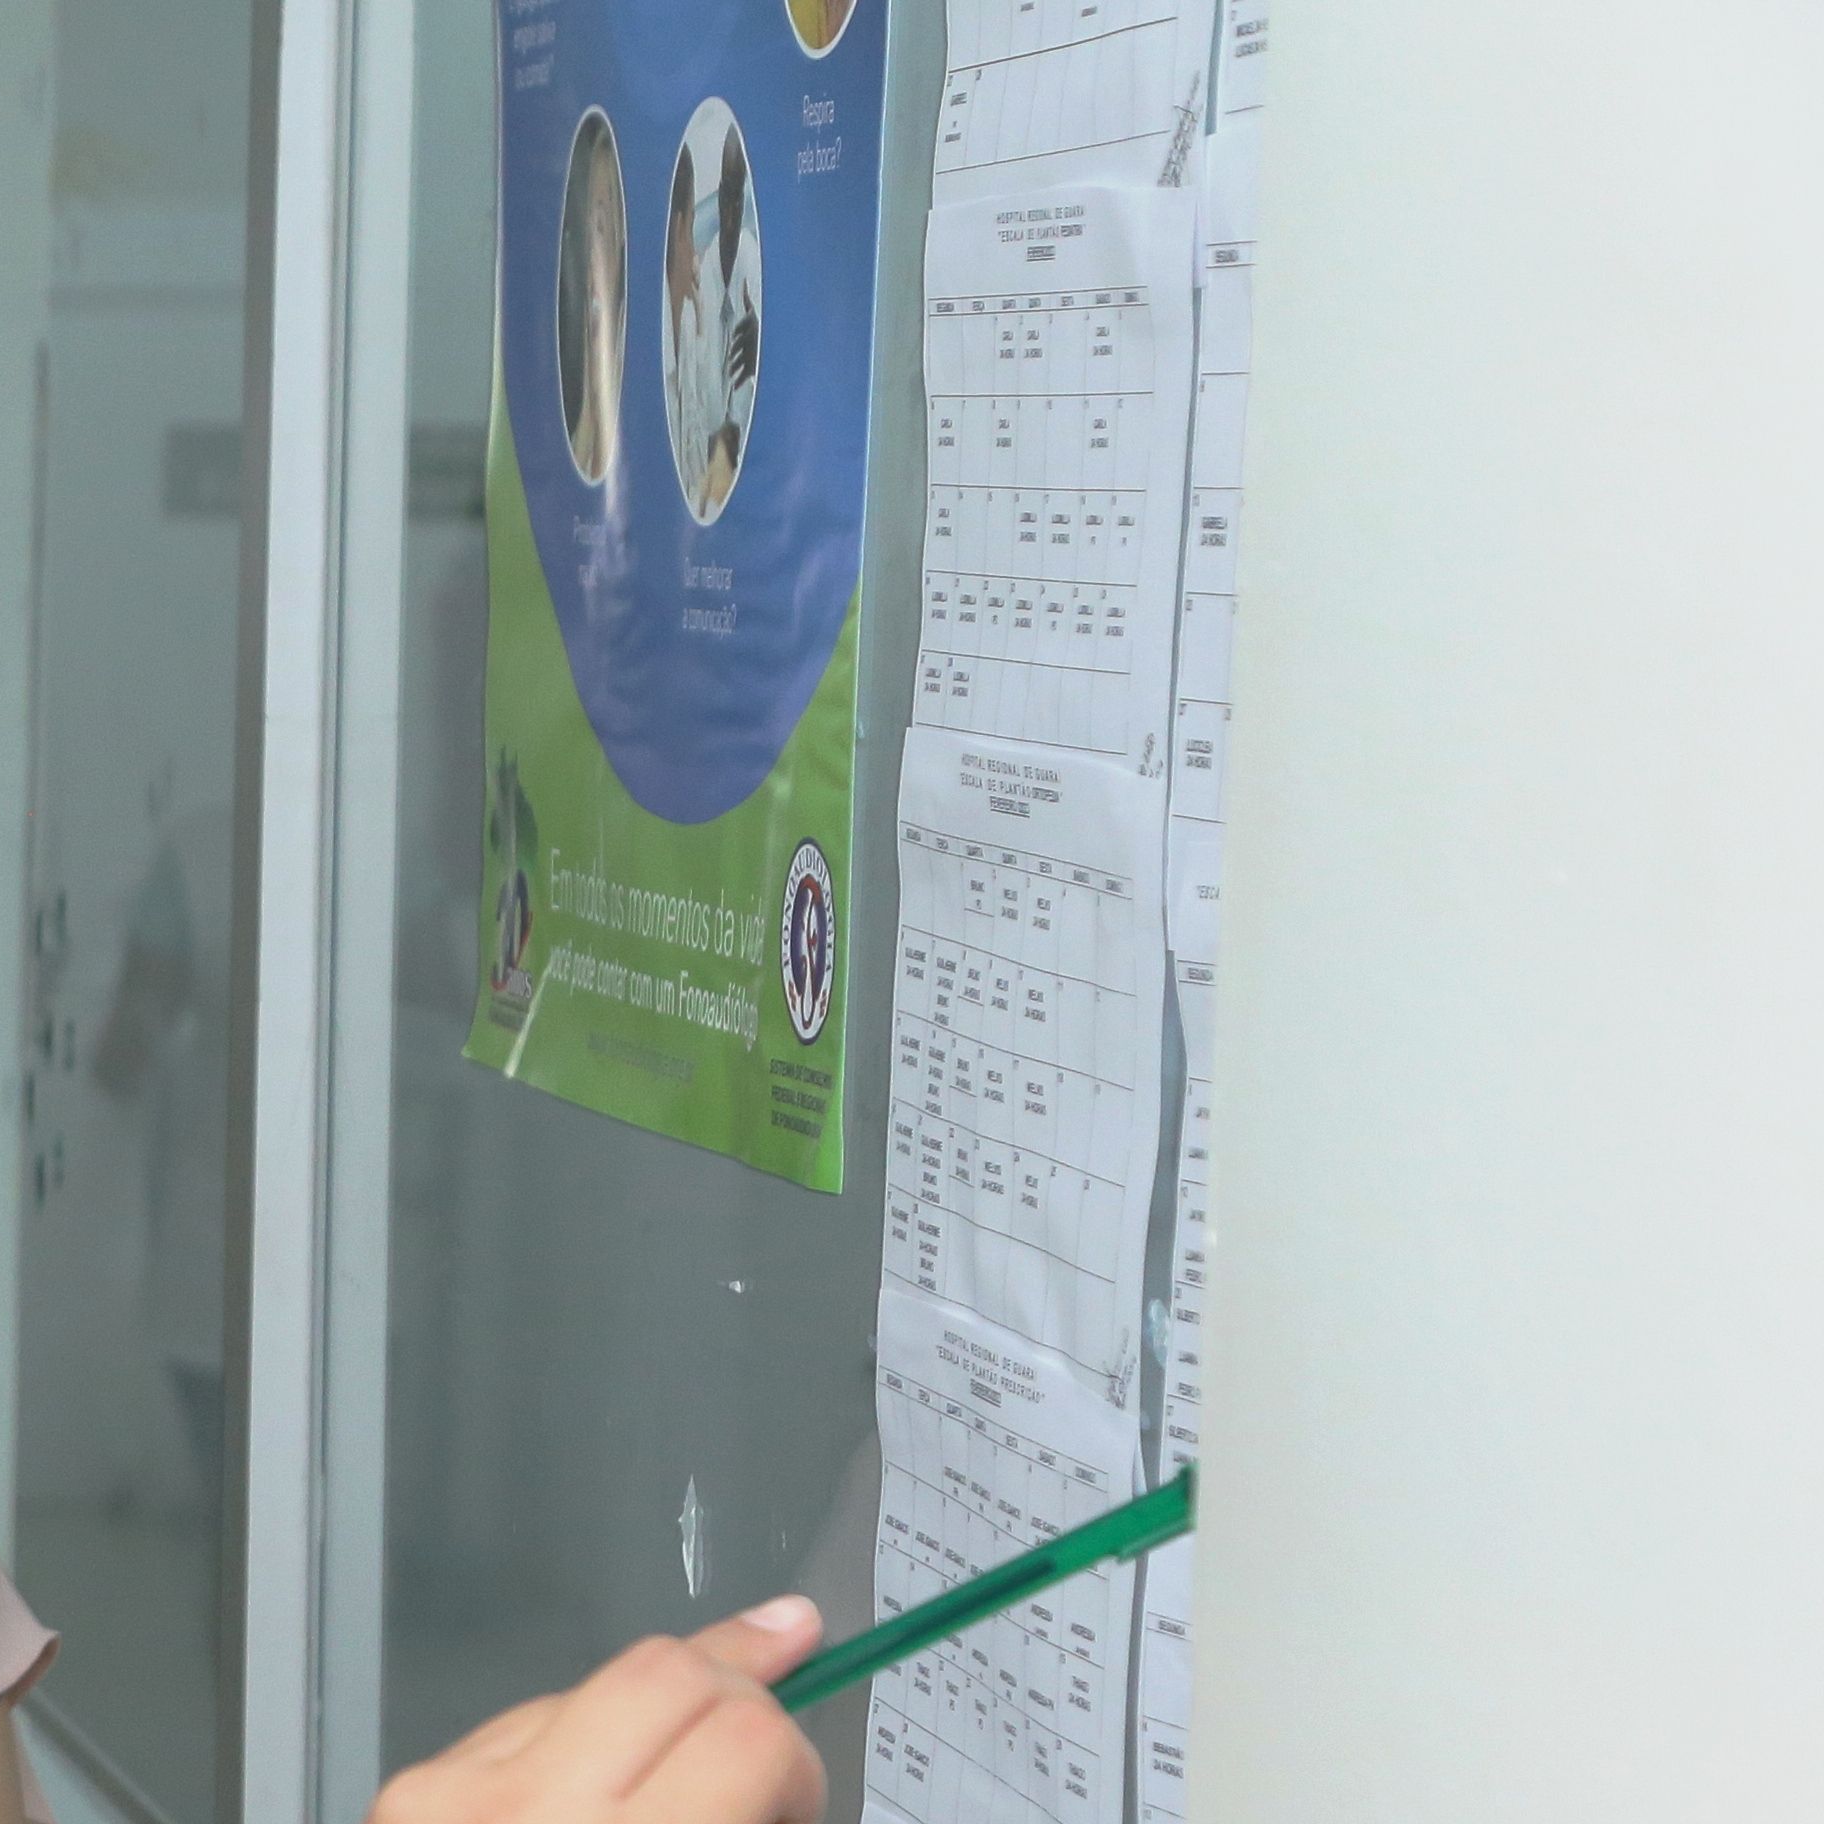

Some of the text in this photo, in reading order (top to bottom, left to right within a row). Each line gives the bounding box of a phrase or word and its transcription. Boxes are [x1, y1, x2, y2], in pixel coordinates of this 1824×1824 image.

[803, 94, 835, 134] Respira
[816, 136, 842, 171] boca?
[1024, 766, 1033, 779] DE
[551, 848, 766, 967] Em todos os momentos da vida
[630, 970, 653, 1010] com
[655, 978, 675, 1016] um
